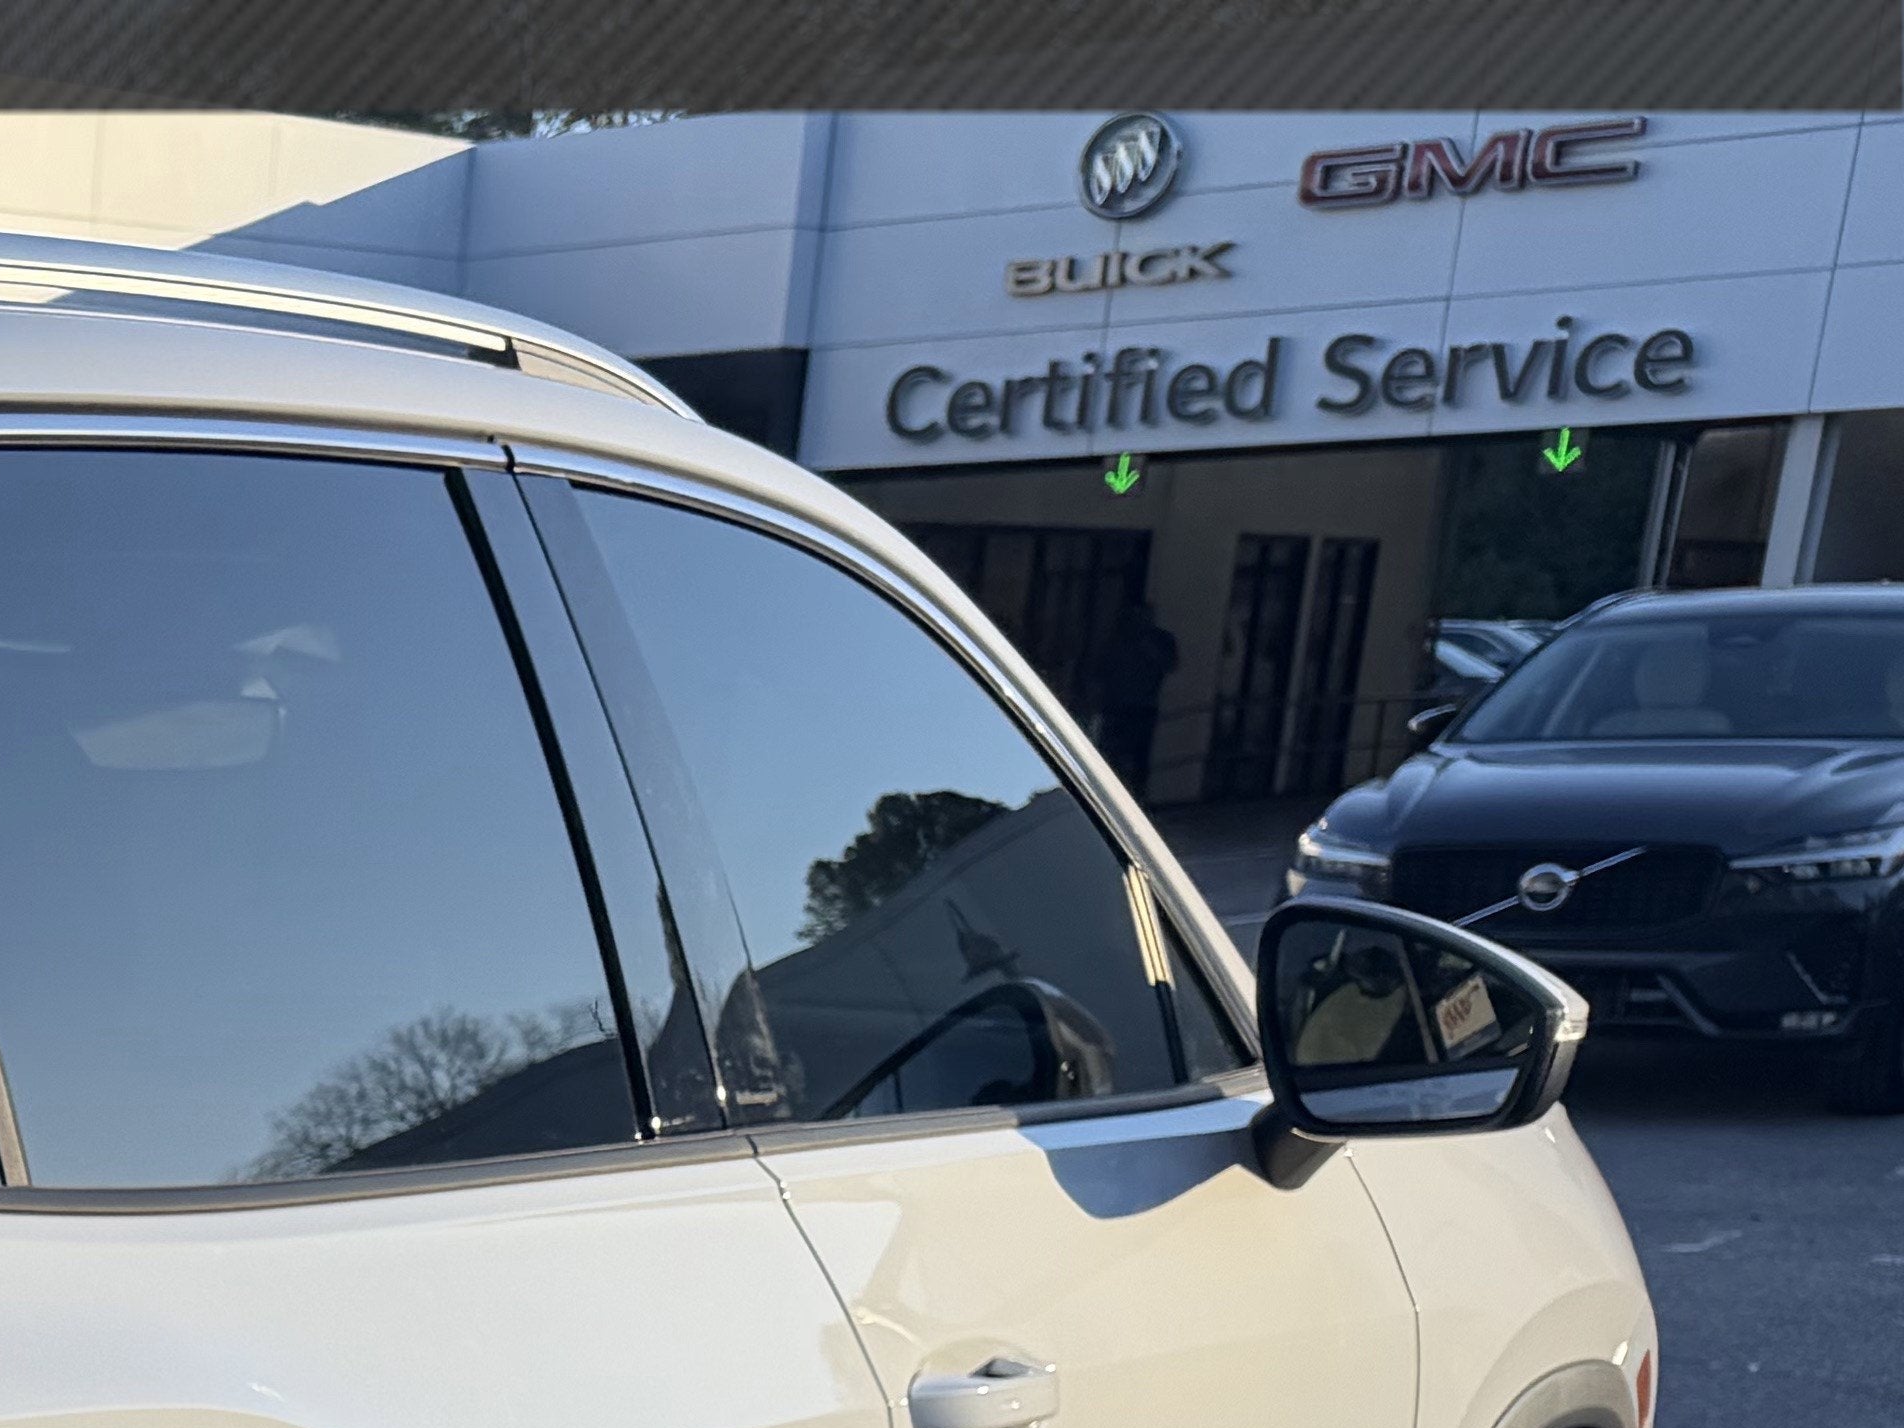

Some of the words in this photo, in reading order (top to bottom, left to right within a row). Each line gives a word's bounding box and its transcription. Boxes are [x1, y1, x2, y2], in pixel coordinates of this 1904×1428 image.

[1299, 115, 1649, 212] GMC
[1006, 241, 1237, 297] BUICK
[886, 336, 1284, 444] Certified
[1316, 316, 1697, 417] Service
